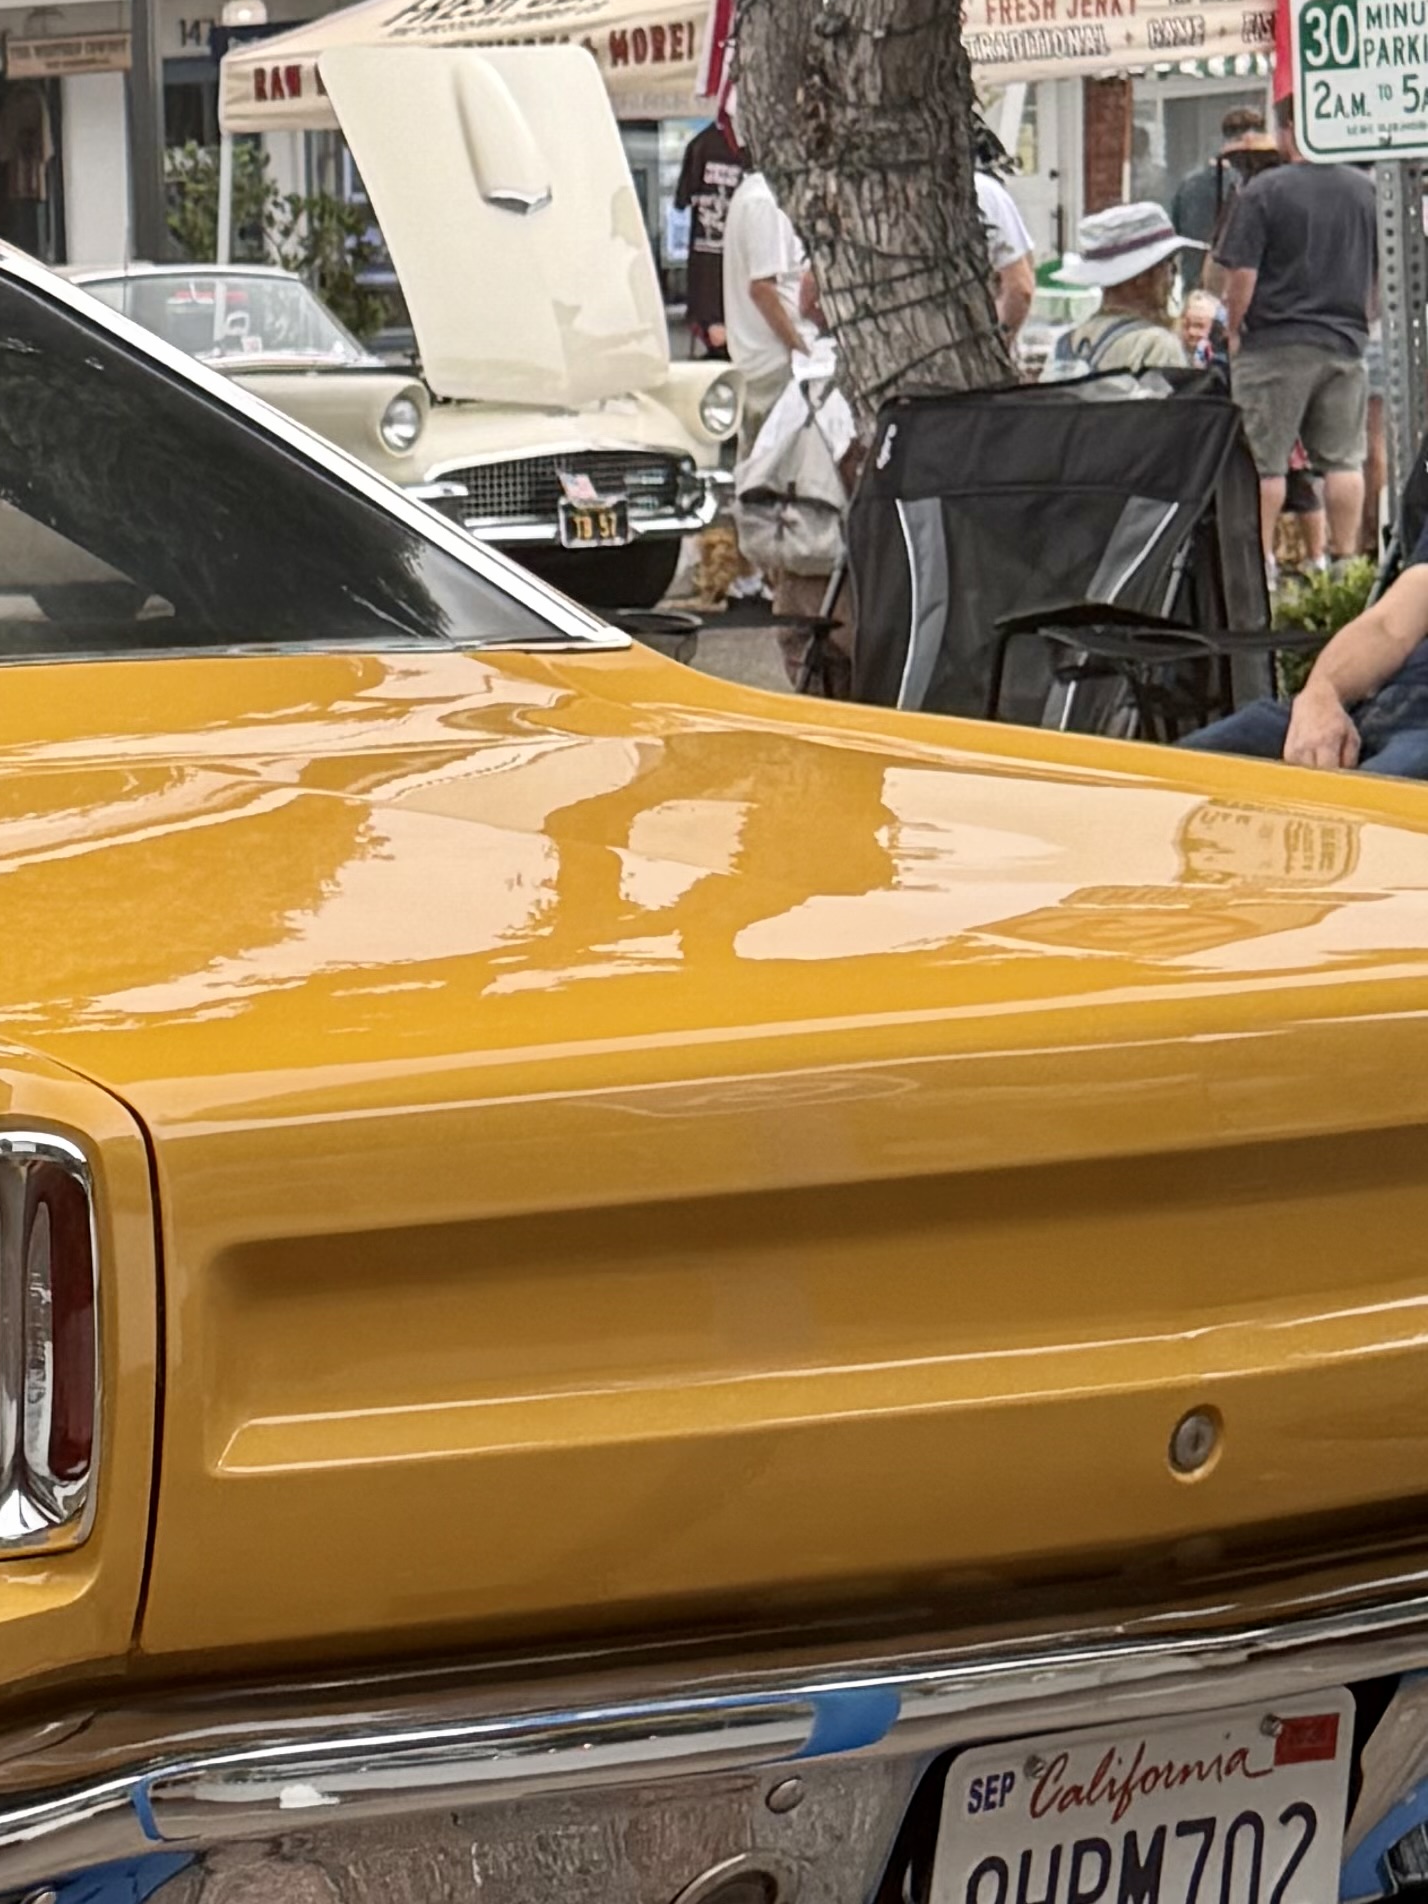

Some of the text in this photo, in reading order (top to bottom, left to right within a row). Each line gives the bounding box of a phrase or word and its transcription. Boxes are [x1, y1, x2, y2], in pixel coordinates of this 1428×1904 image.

[1304, 3, 1356, 67] 30
[1365, 0, 1428, 31] MINU
[253, 63, 302, 102] RAW
[1378, 83, 1393, 101] TO
[967, 1741, 1275, 1823] SEP California
